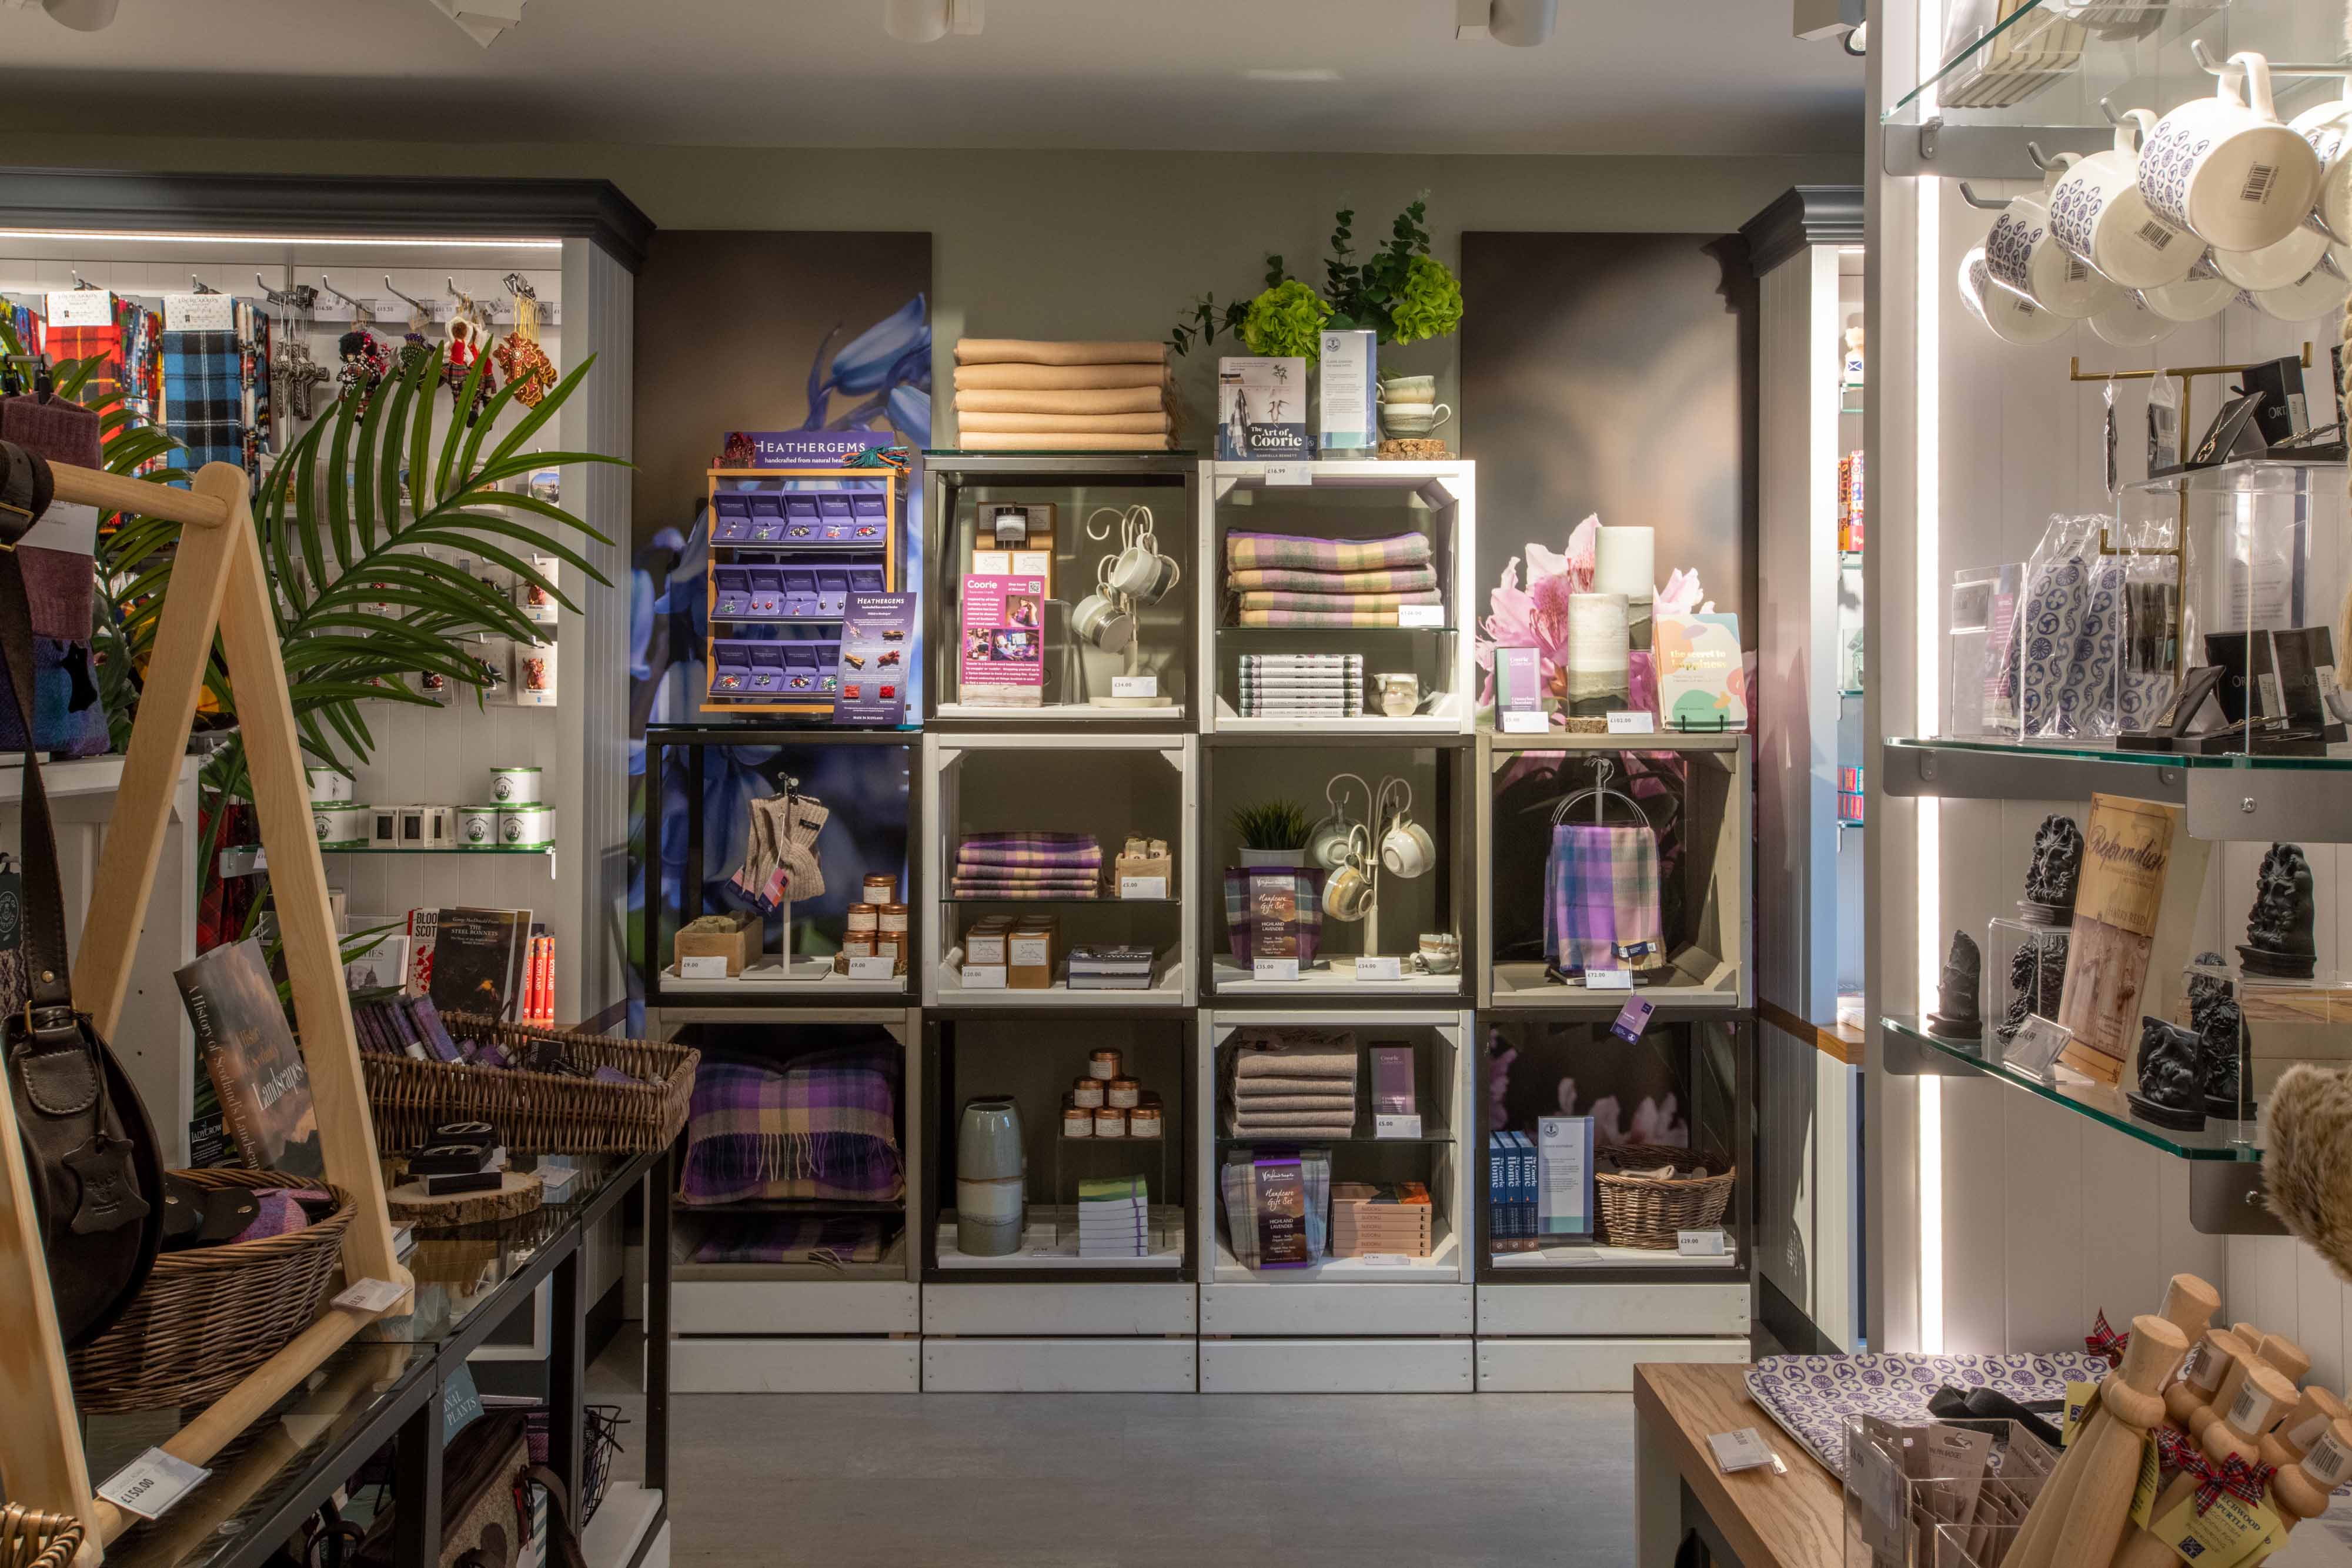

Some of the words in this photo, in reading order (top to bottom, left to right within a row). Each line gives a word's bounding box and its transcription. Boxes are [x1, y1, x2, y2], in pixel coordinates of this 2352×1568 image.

[2268, 406, 2287, 419] ORT
[1278, 428, 1289, 436] of
[755, 440, 866, 453] HEATHERGEMS
[1251, 434, 1302, 447] Coorie
[968, 580, 998, 589] Coorie
[1671, 650, 1685, 658] the
[1716, 650, 1726, 658] to
[1671, 658, 1727, 671] happiness
[2091, 825, 2166, 871] Reformation
[1259, 894, 1287, 902] Handcare
[1261, 901, 1274, 915] Gift
[416, 912, 437, 924] BLOO
[415, 925, 437, 937] SCOT
[191, 991, 212, 1038] History
[208, 1039, 221, 1053] of
[212, 1055, 242, 1119] Scotland's
[252, 1062, 305, 1111] Landscapes
[1491, 1157, 1500, 1188] Home
[1508, 1156, 1516, 1188] Home
[1524, 1156, 1533, 1188] Home
[1265, 1188, 1294, 1198] Handcare
[1267, 1196, 1281, 1212] Gift
[1282, 1196, 1294, 1205] Set
[444, 1390, 463, 1412] INAL
[447, 1396, 477, 1426] PLANTS
[1731, 1431, 1749, 1445] £20.00
[1945, 1449, 1962, 1459] BADGES
[121, 1478, 154, 1503] £150.00
[2220, 1494, 2260, 1530] ECHWOOD
